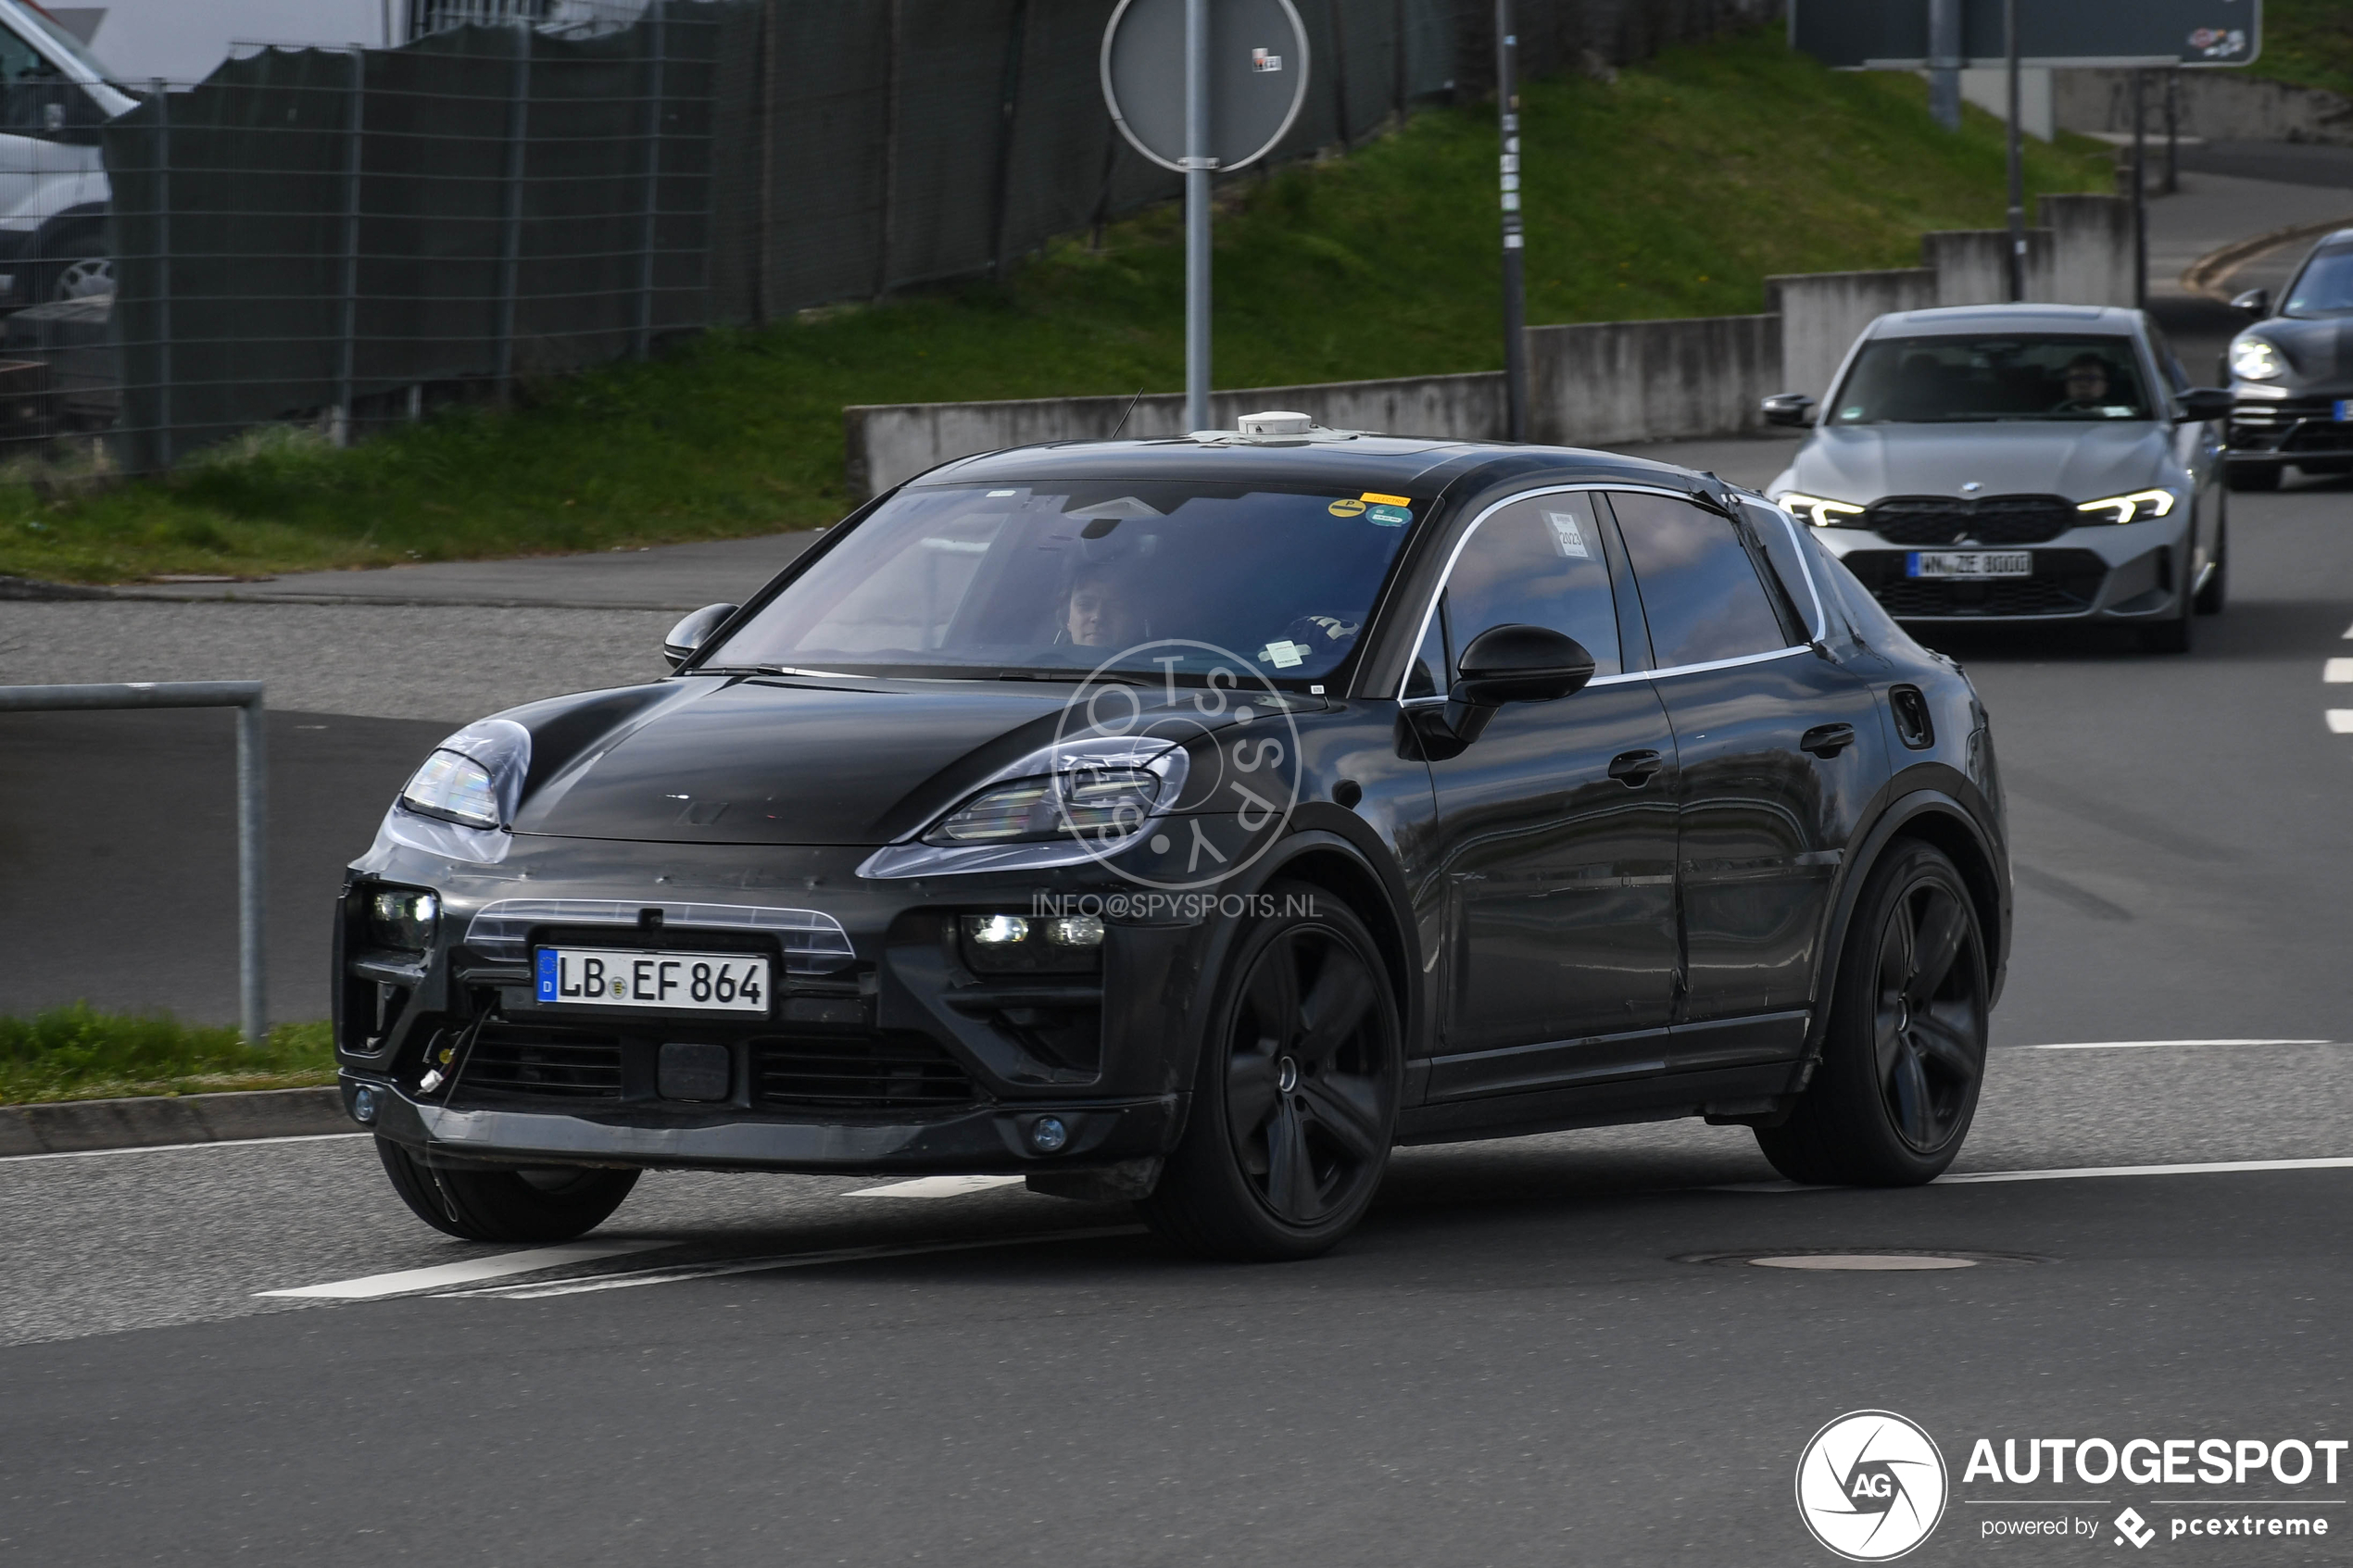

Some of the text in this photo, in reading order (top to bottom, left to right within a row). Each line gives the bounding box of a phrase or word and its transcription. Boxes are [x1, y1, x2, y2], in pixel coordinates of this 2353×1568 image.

[1373, 495, 1408, 505] ELECTRIC
[1559, 532, 1582, 546] 2023
[1956, 555, 1978, 573] ZE
[543, 981, 553, 993] D
[560, 956, 761, 1004] LB EF 864
